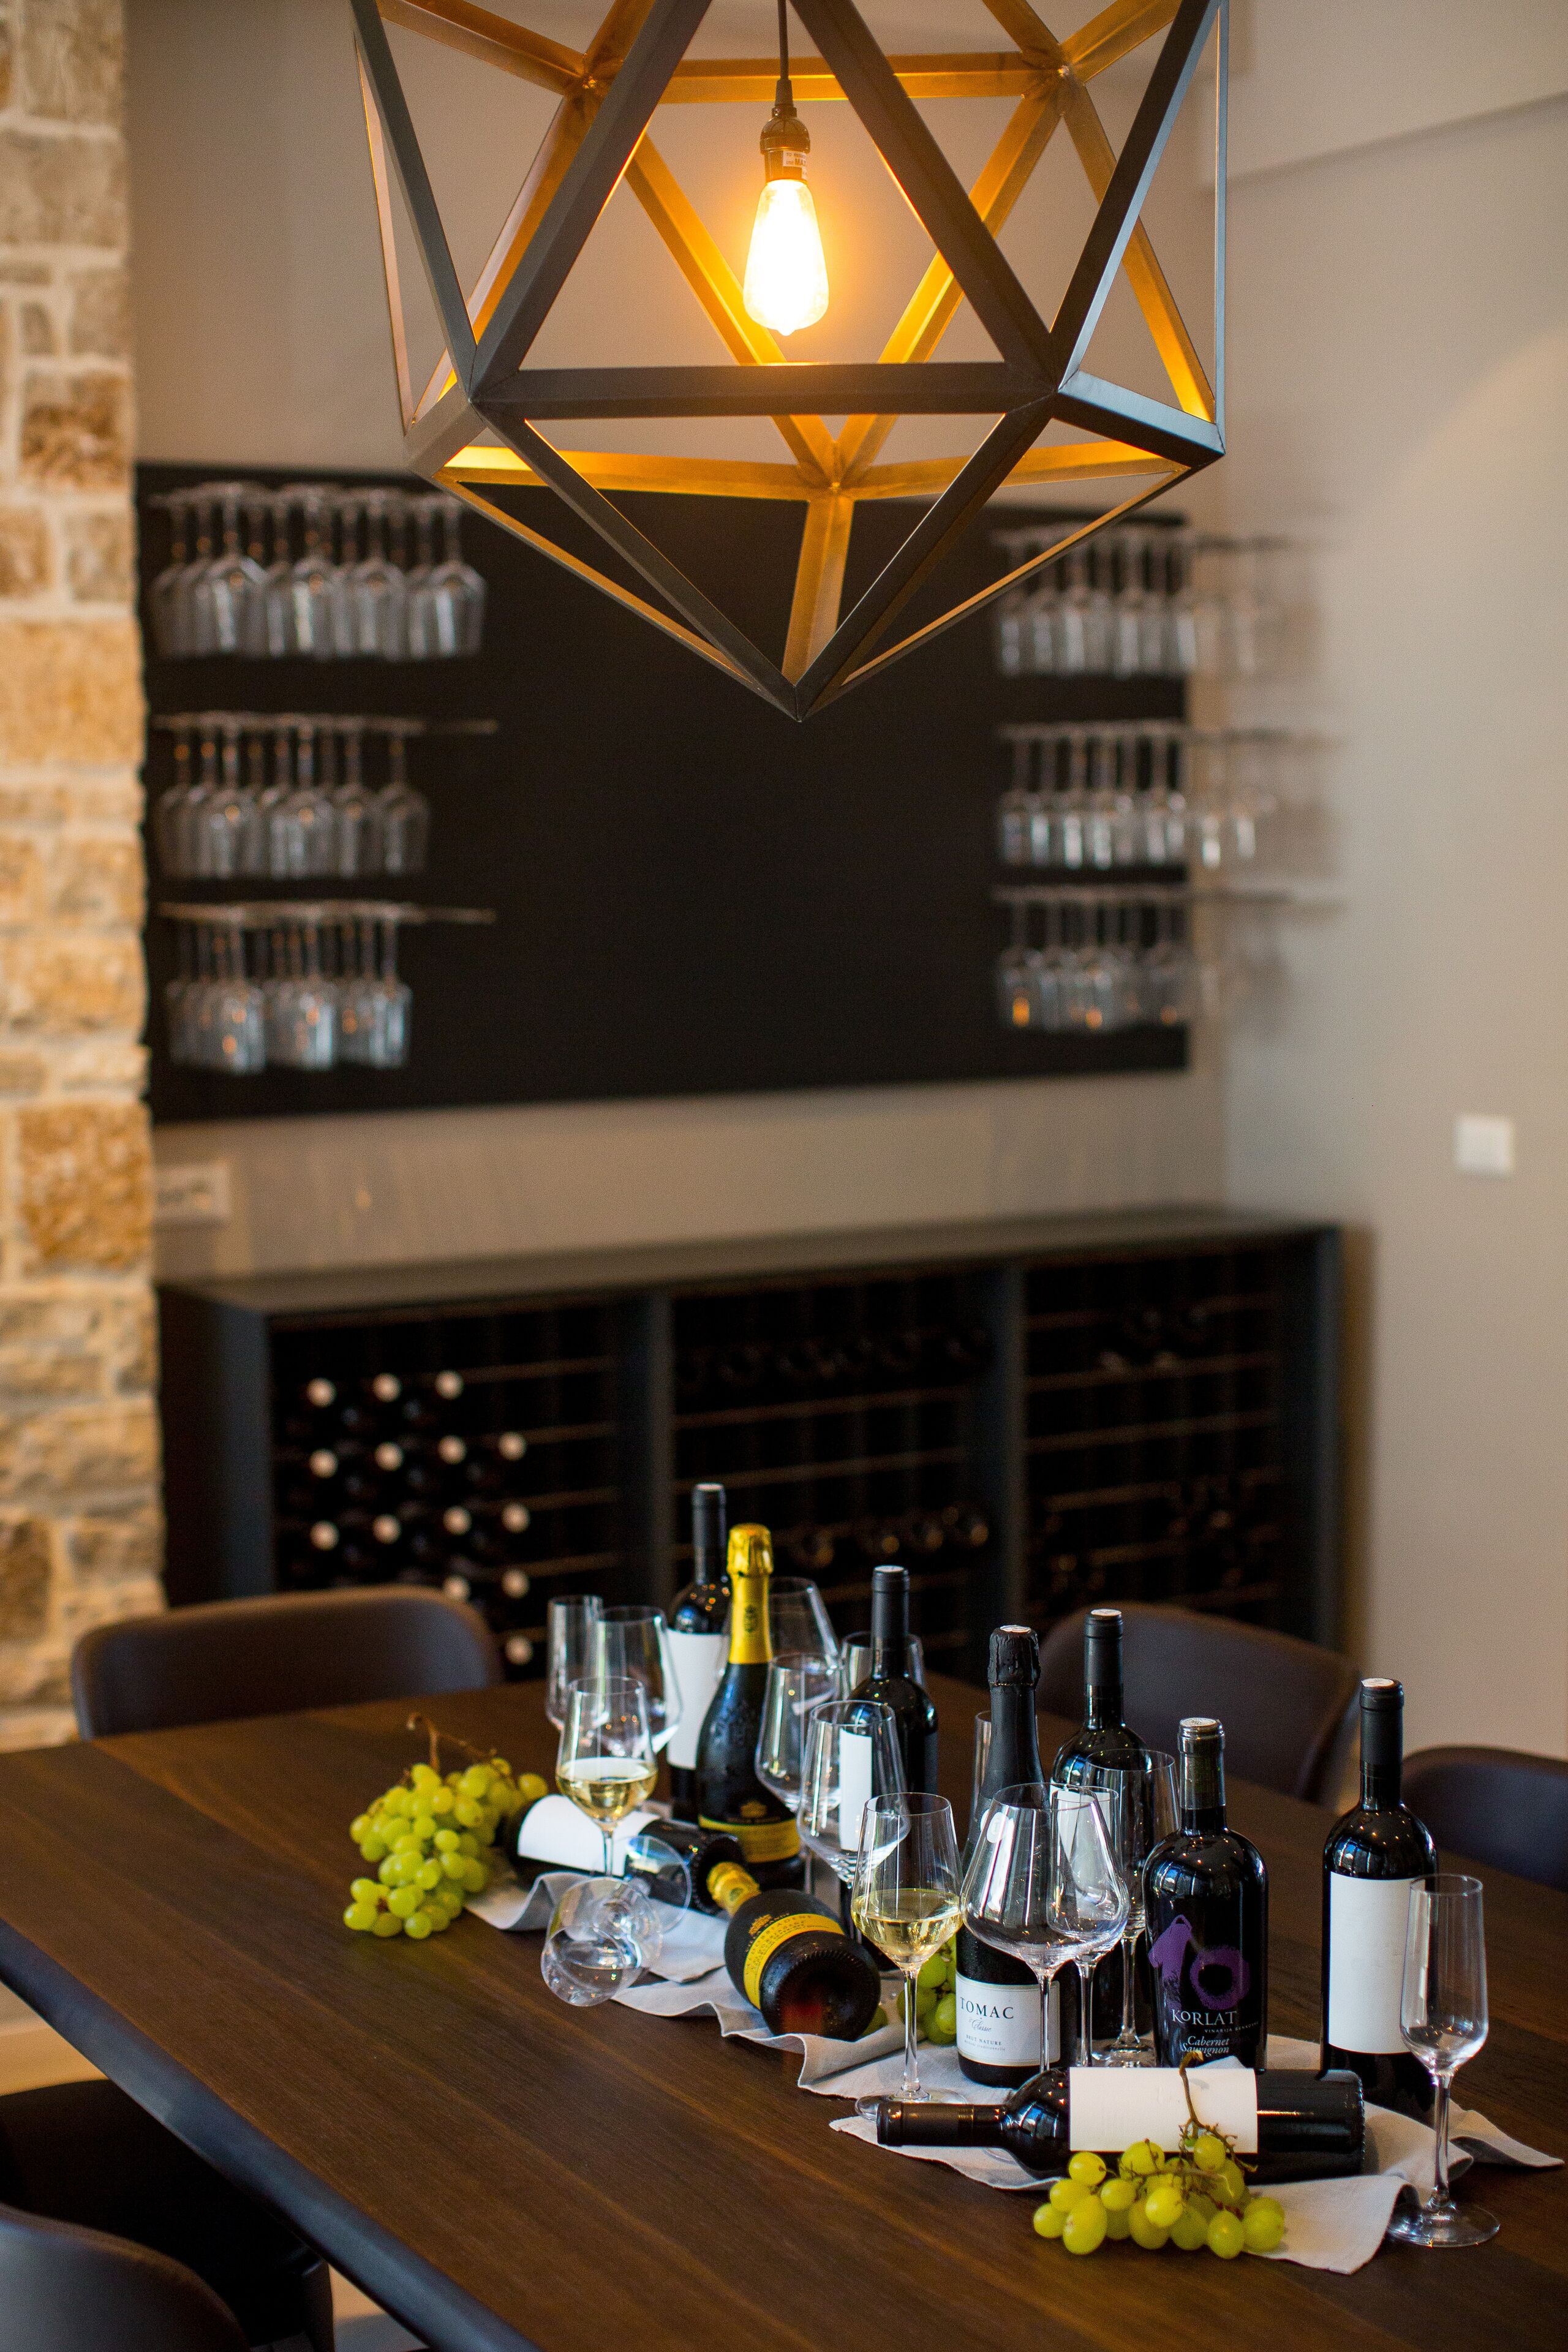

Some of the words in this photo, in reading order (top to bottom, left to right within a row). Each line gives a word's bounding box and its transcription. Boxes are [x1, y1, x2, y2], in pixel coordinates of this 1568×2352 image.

[960, 1997, 1014, 2019] TOMAC
[1171, 2009, 1237, 2026] KORLAT
[1187, 2035, 1230, 2046] Cabernet
[1182, 2042, 1230, 2057] Sauvignon
